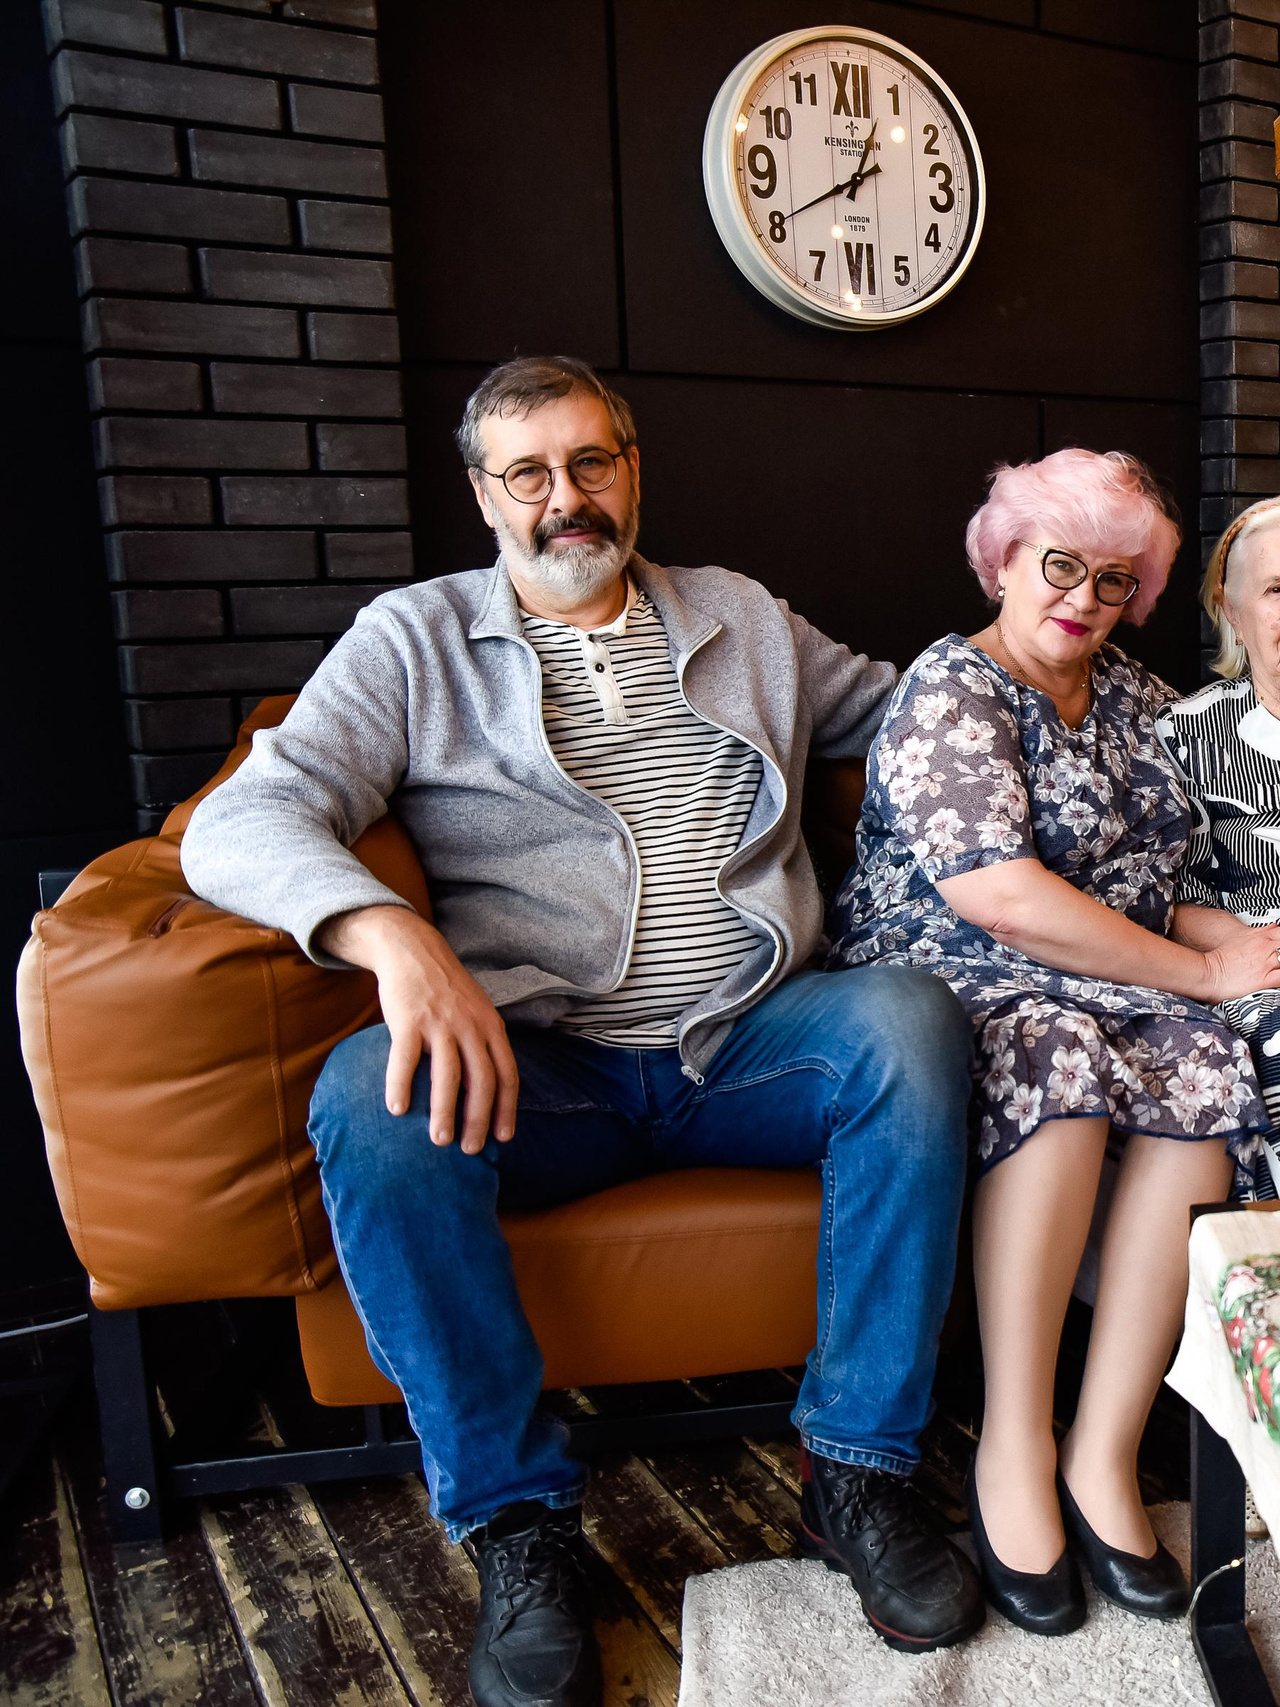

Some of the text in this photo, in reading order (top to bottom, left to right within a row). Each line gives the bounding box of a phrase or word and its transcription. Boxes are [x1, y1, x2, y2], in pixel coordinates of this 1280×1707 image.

[789, 71, 818, 106] 11
[830, 61, 871, 119] XII
[887, 84, 900, 116] 1
[759, 105, 792, 140] 10
[824, 136, 881, 151] KENSINGN
[923, 124, 940, 155] 2
[748, 144, 777, 199] 9
[929, 162, 955, 213] 3
[769, 211, 787, 244] 8
[844, 215, 870, 223] LONDON
[850, 224, 866, 232] 1879
[925, 223, 941, 253] 4
[809, 250, 826, 281] 7
[844, 242, 876, 295] VI
[894, 255, 911, 287] 5
